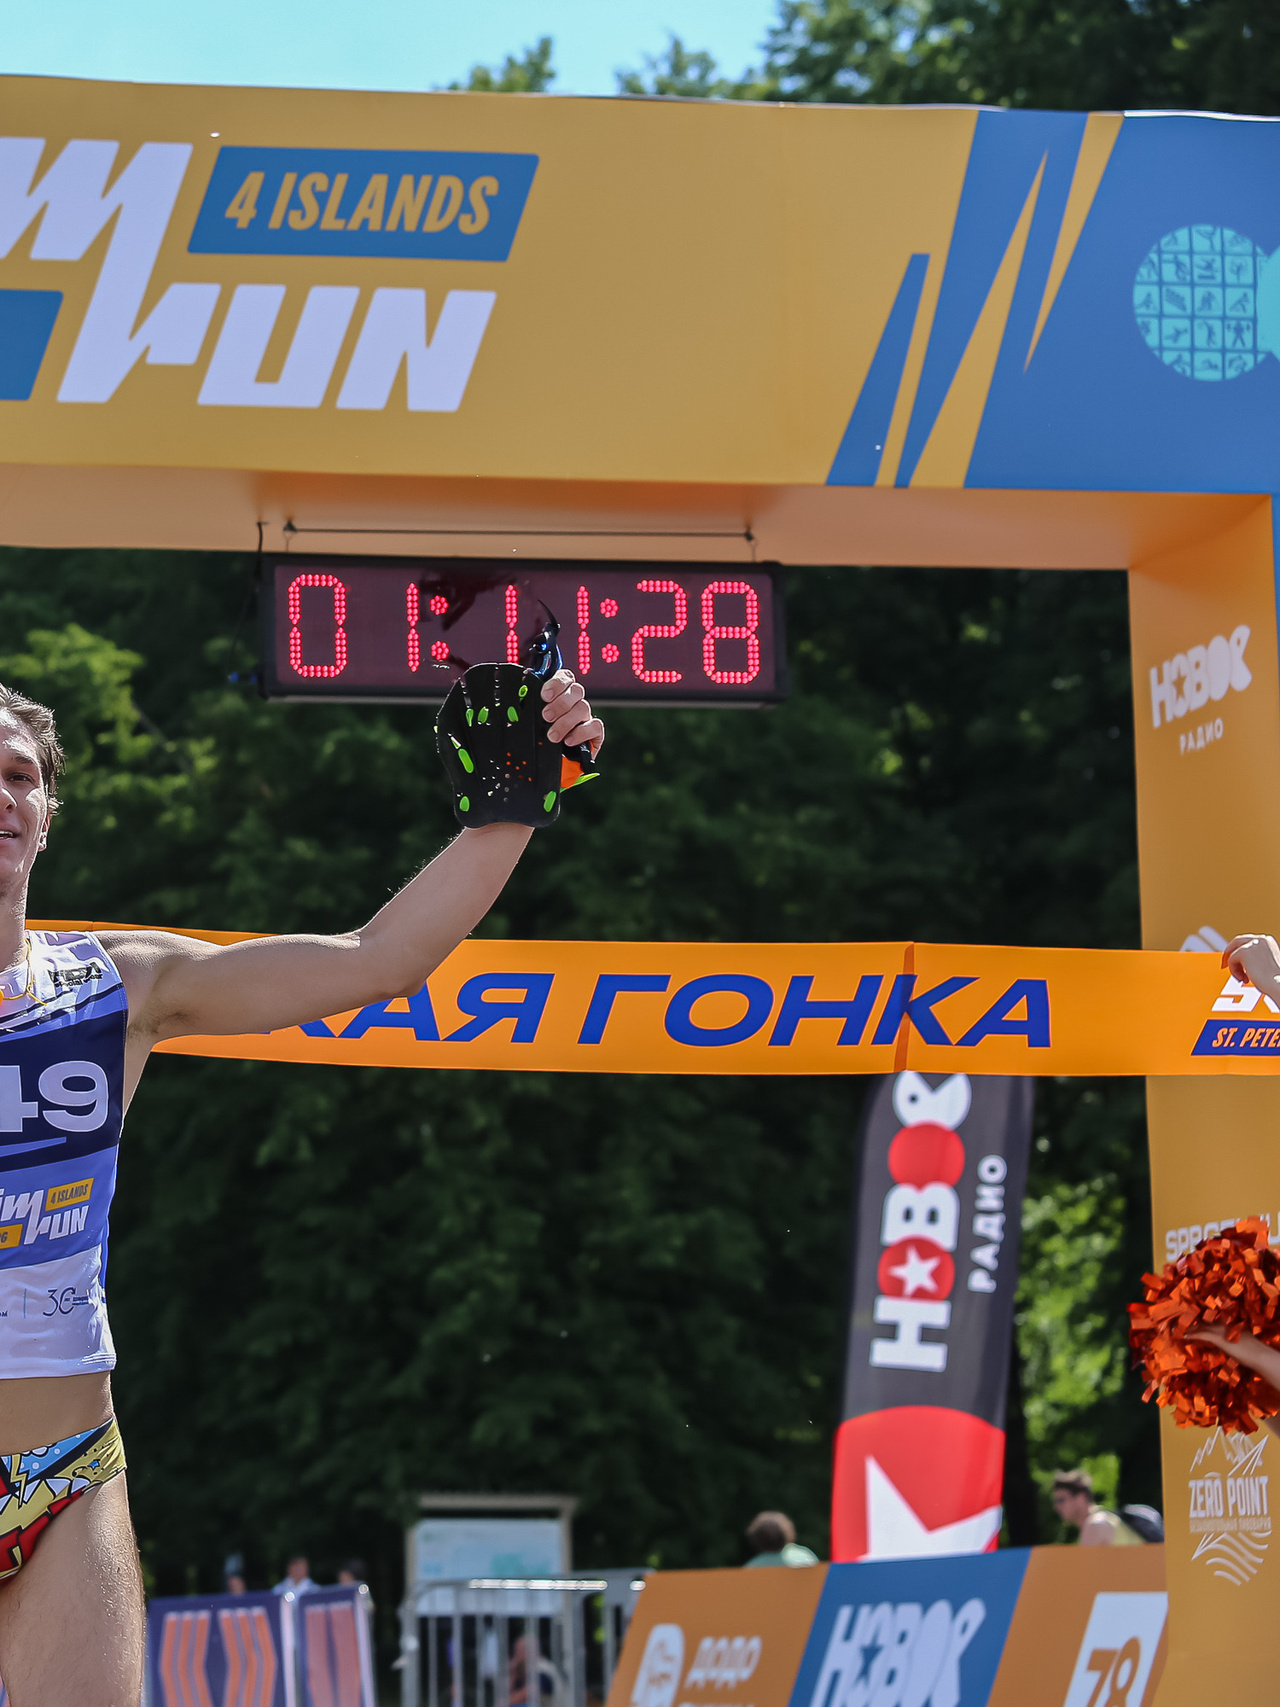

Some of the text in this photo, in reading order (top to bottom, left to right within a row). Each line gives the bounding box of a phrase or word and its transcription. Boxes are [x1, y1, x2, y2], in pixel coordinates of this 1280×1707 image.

[223, 171, 500, 236] 4 ISLANDS
[287, 573, 761, 685] 01:11:28
[1179, 717, 1225, 755] РАДИО
[260, 972, 1053, 1048] АЯ ГОНКА
[1211, 1027, 1280, 1049] ST. PETE
[50, 1184, 89, 1204] 4 ISLANDS
[967, 1154, 1008, 1294] РАДИО
[1188, 1475, 1269, 1518] ZERO POINT
